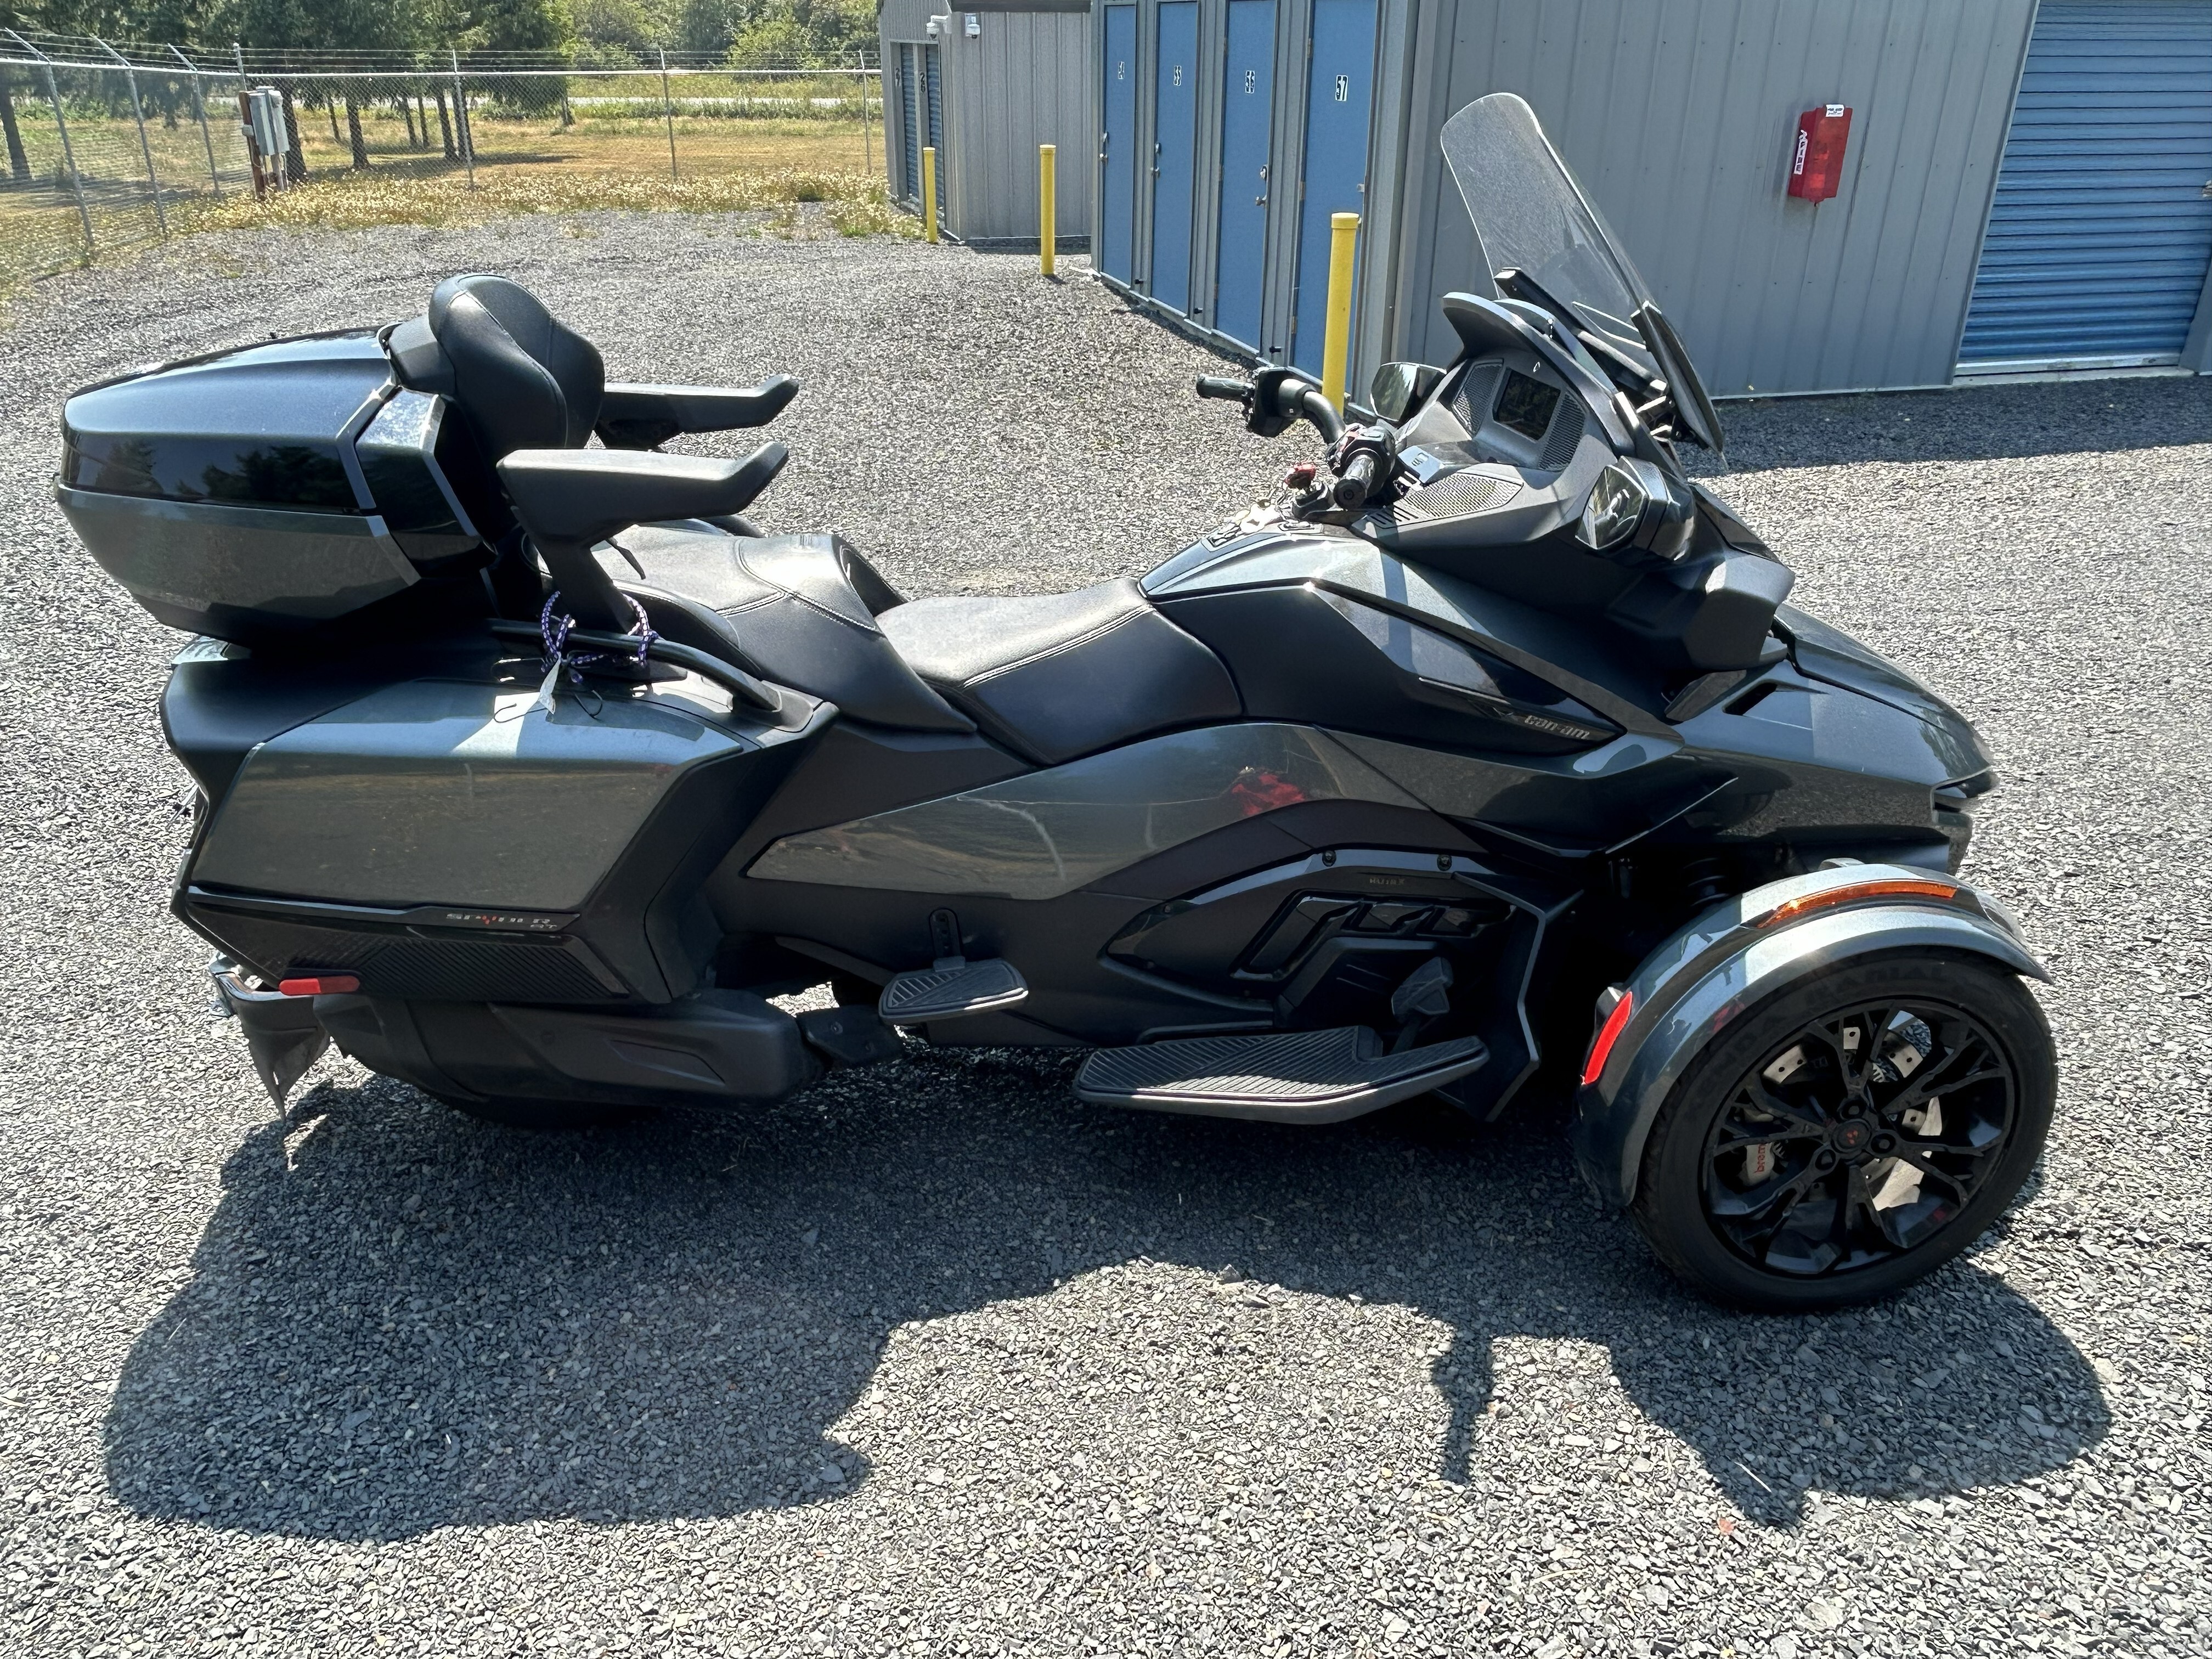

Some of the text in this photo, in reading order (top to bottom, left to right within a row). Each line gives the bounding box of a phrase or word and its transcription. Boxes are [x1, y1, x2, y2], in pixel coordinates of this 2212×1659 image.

[920, 72, 926, 92] 26
[1335, 76, 1347, 100] 57
[1524, 714, 1590, 740] can-am
